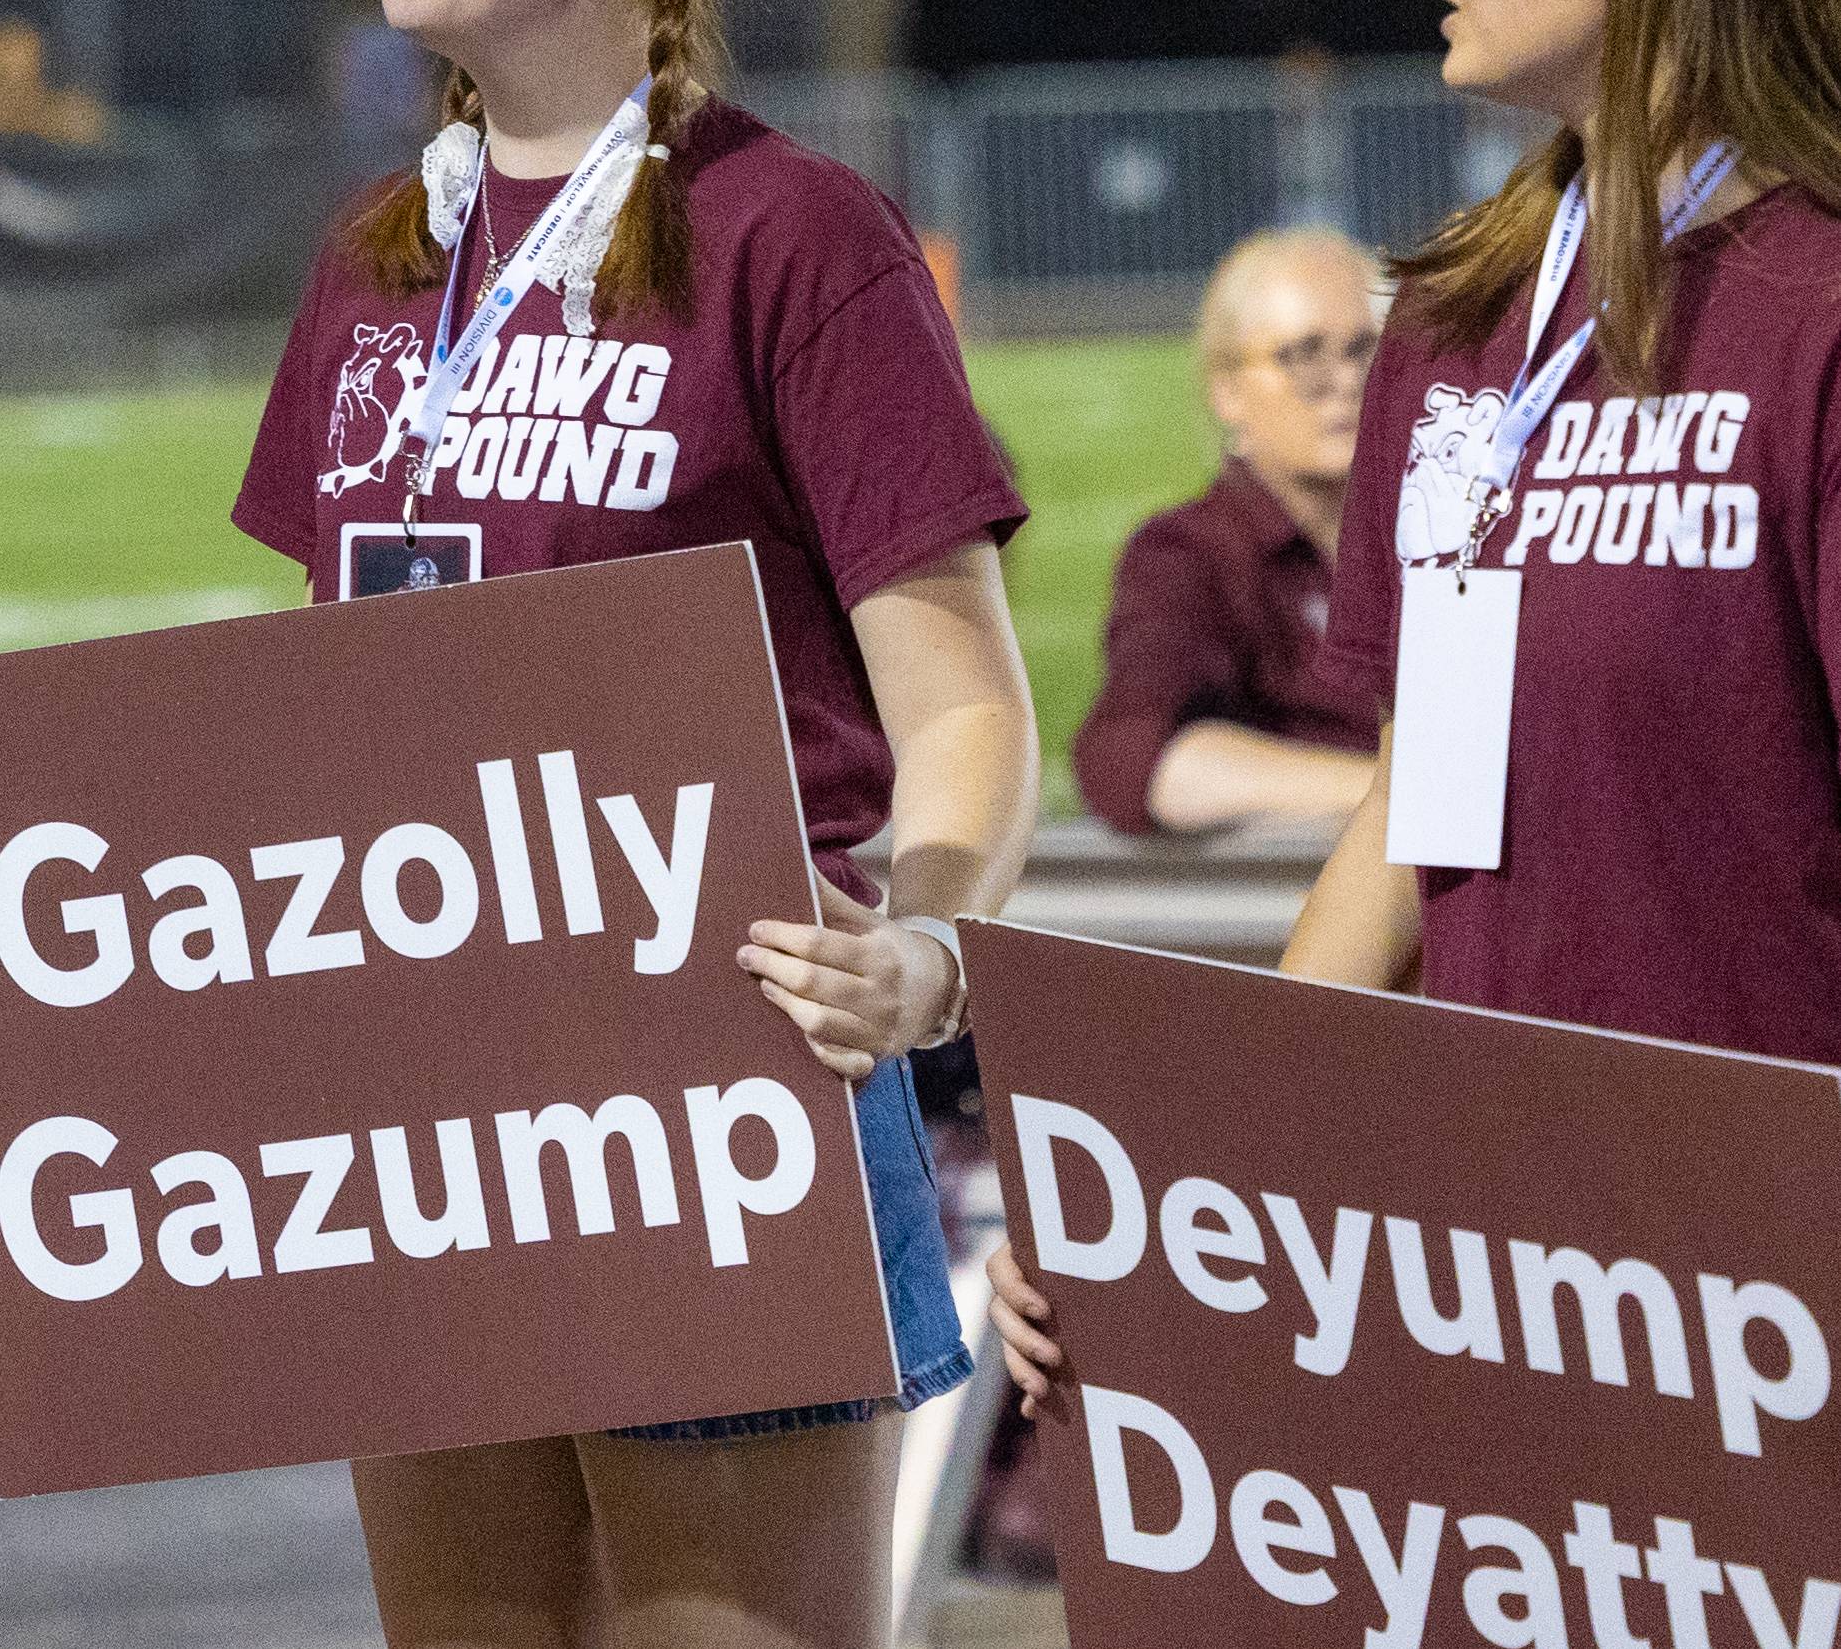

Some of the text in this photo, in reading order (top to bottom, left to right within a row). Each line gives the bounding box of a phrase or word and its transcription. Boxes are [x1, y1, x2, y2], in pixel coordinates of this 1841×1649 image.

[526, 214, 562, 262] DEDICATE
[446, 333, 672, 427] DAWG
[450, 309, 497, 375] DIVISION III
[420, 415, 680, 512] POUND
[1534, 391, 1751, 480] DAWG
[1504, 482, 1759, 570] POUND
[1011, 1094, 1830, 1457] Deyump
